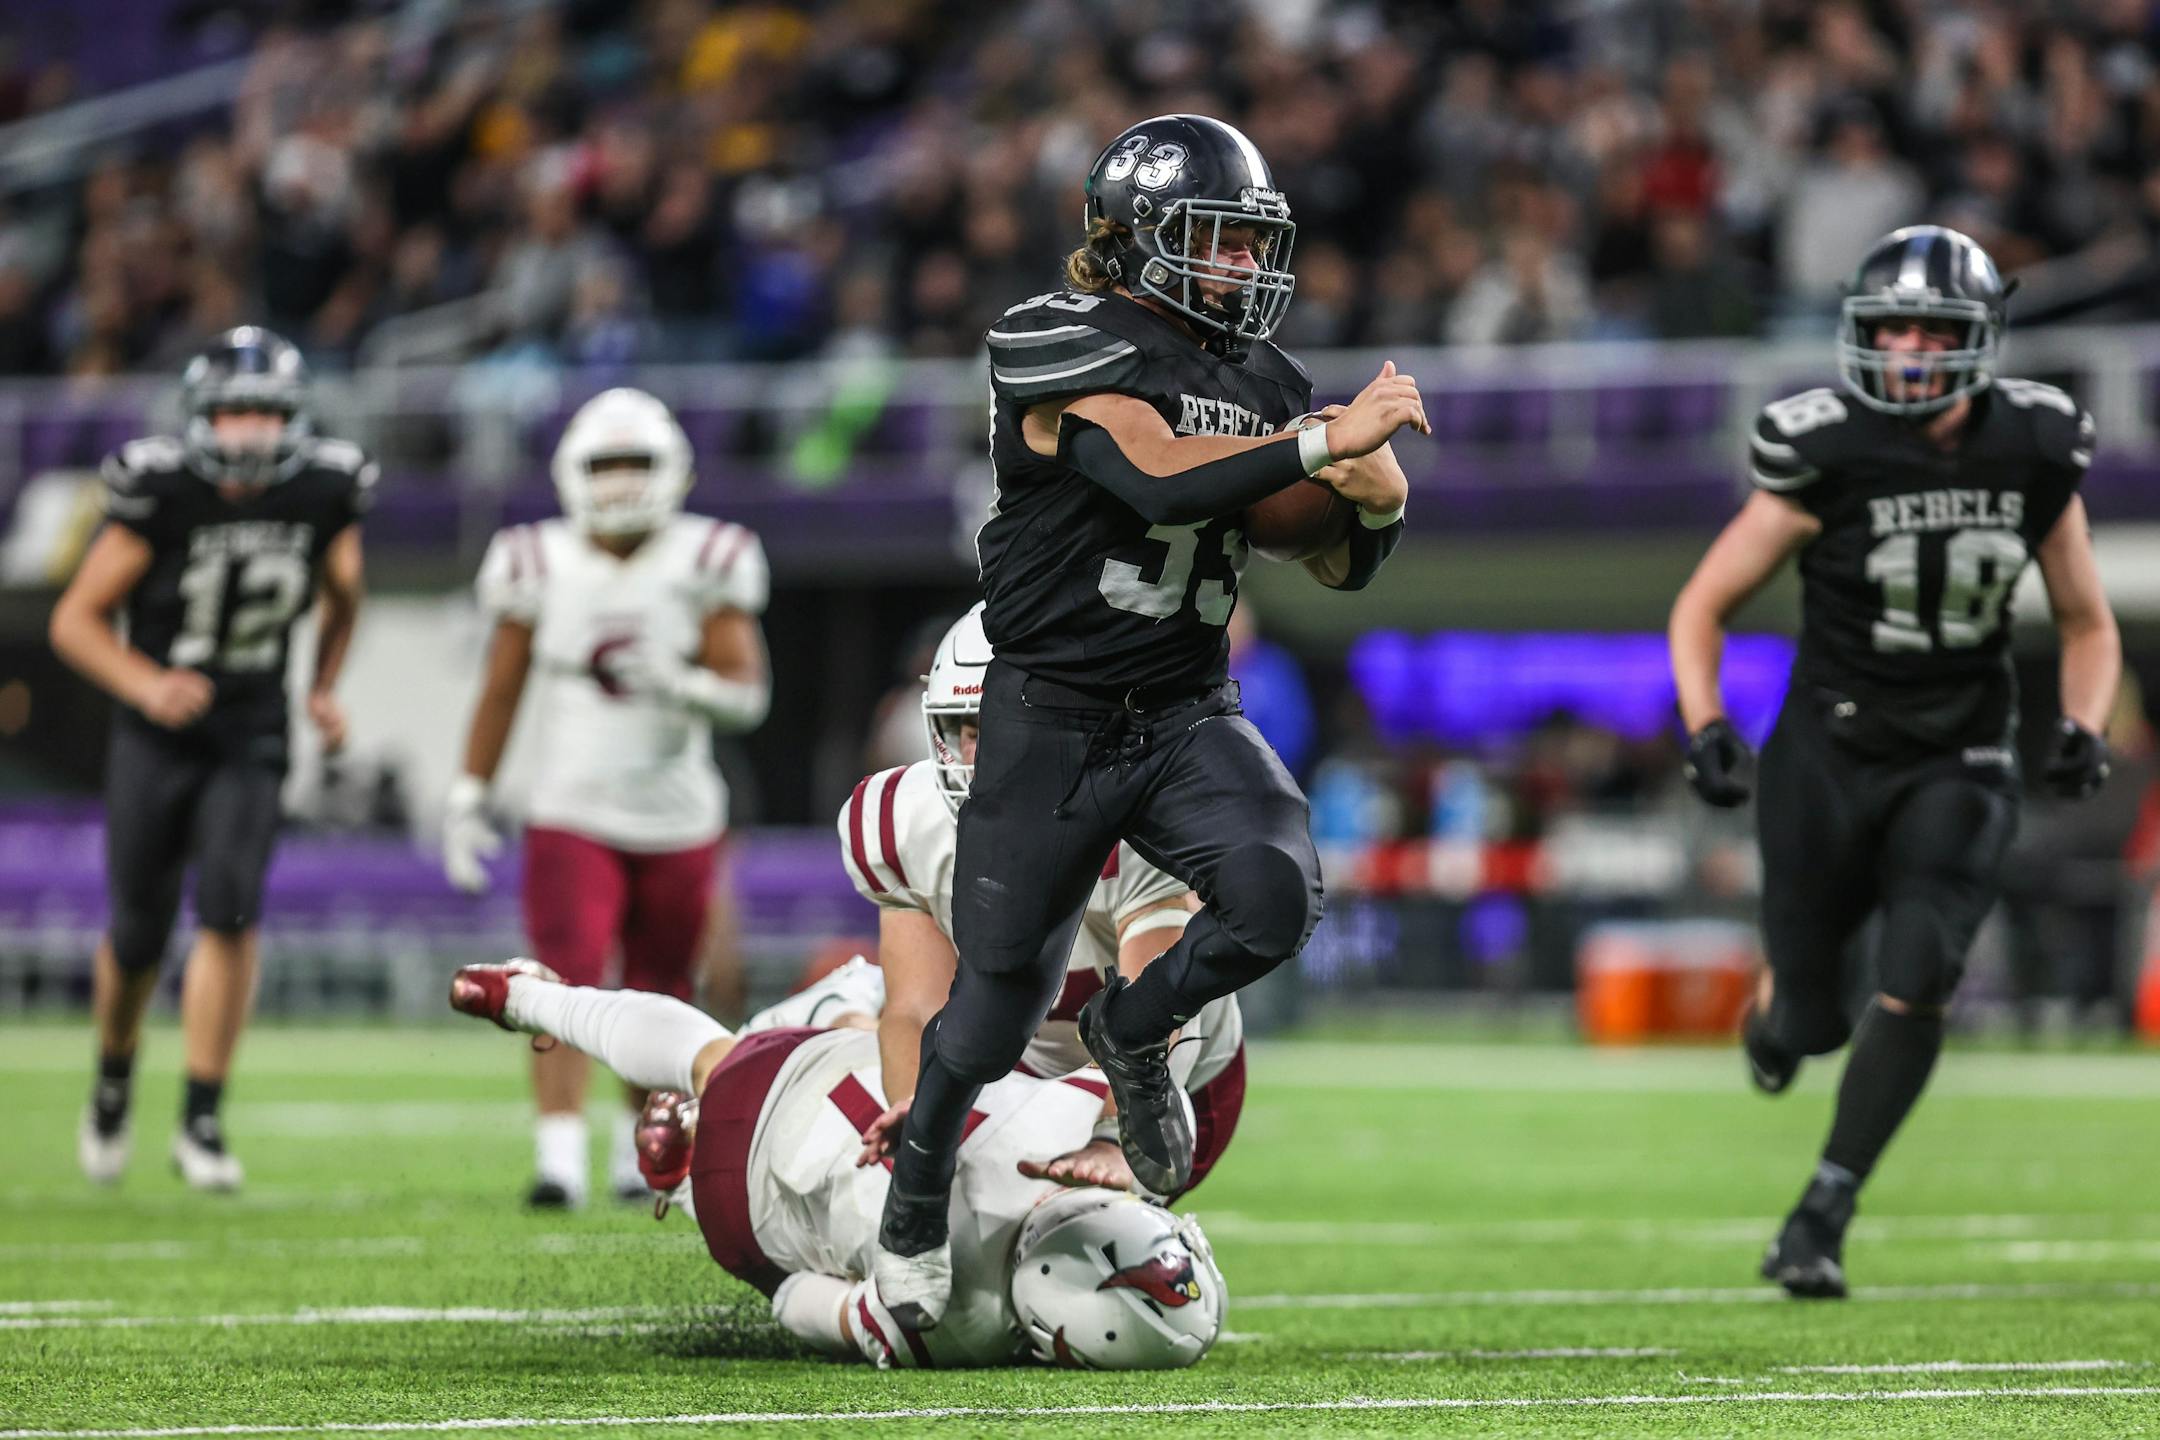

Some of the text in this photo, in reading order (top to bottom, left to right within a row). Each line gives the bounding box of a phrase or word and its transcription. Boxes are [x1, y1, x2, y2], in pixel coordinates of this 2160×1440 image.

[1105, 135, 1190, 192] 33
[1868, 488, 2024, 537] REBELS
[168, 550, 310, 671] 12
[1865, 528, 2028, 653] 18
